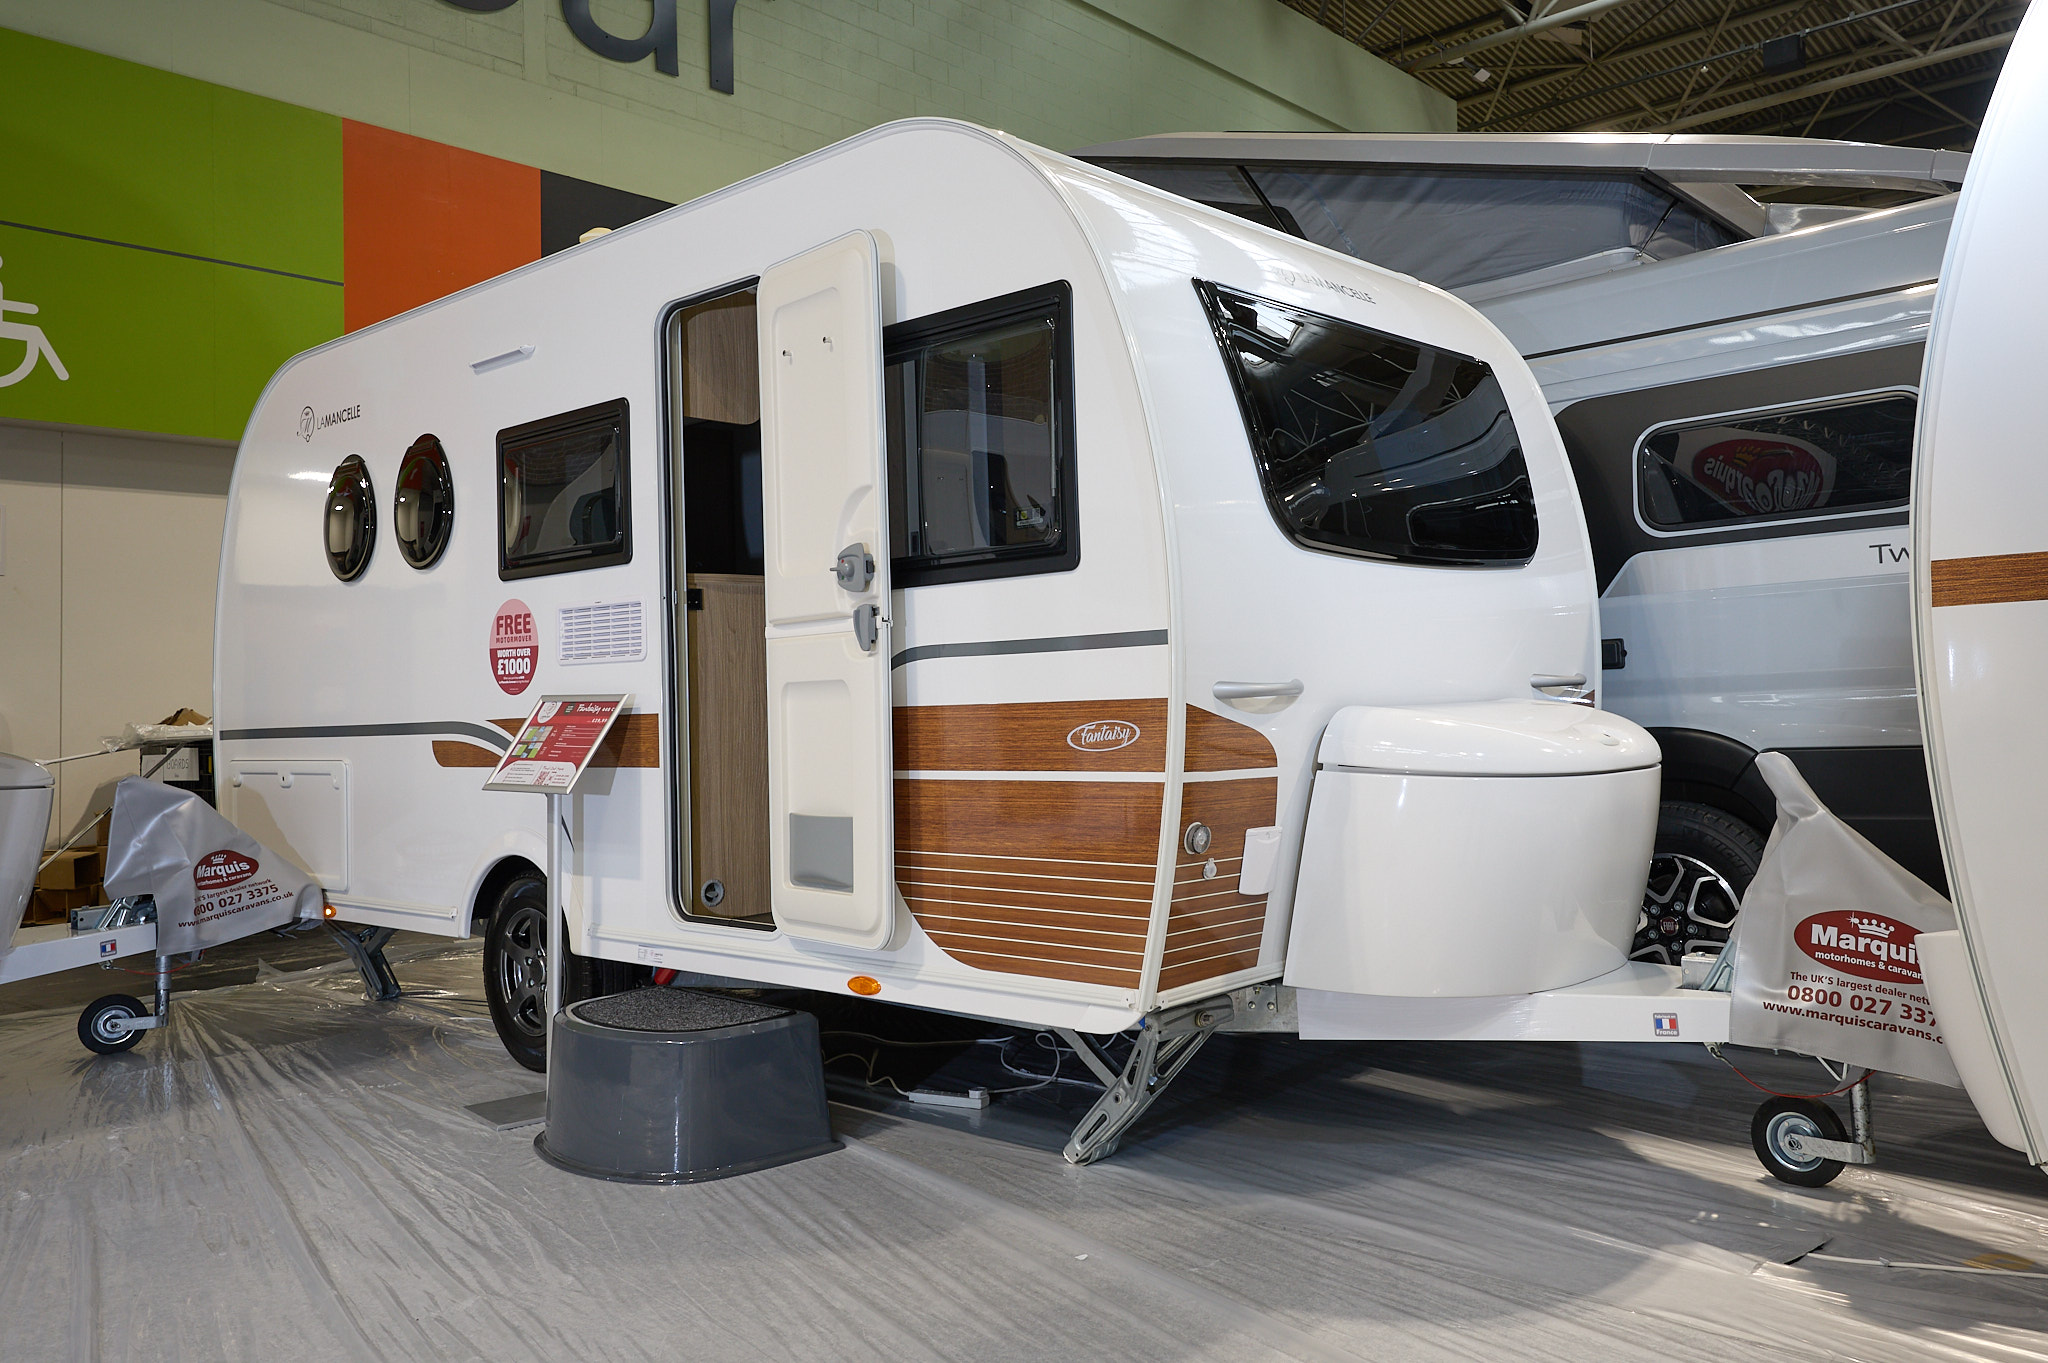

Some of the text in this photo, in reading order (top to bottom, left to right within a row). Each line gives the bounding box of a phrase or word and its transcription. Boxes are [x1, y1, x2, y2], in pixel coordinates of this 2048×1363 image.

[316, 404, 361, 430] LAMANCELLE
[496, 612, 532, 636] FREE
[495, 634, 532, 644] MOTORMOVER
[496, 647, 531, 658] WORTH OVER
[497, 657, 531, 675] £1000
[1077, 724, 1132, 746] Fantaisy
[197, 860, 251, 879] Marquis
[228, 872, 253, 881] caravans
[207, 889, 229, 899] largest
[229, 884, 247, 893] dealer
[218, 893, 243, 908] 027
[246, 884, 279, 900] 3375
[1810, 923, 1920, 965] Marqui
[1815, 950, 1876, 968] motorhomes
[1878, 961, 1886, 970] &
[1790, 971, 1808, 982] The
[1836, 977, 1872, 992] largest
[1875, 984, 1908, 999] dealer
[1787, 985, 1842, 1008] 0800
[1849, 994, 1892, 1016] 027
